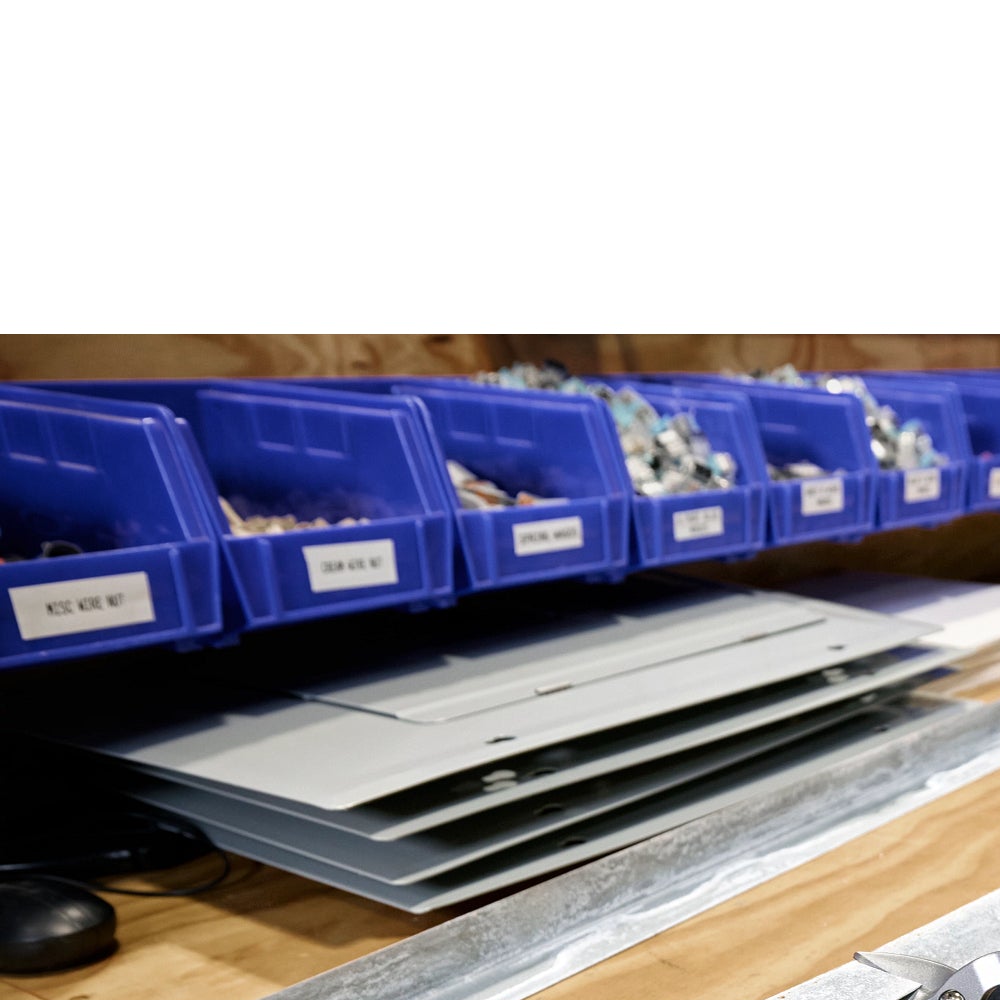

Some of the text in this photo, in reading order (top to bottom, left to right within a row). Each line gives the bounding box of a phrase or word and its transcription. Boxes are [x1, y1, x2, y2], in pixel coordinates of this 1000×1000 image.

[45, 592, 125, 616] MISC WIRE NUT
